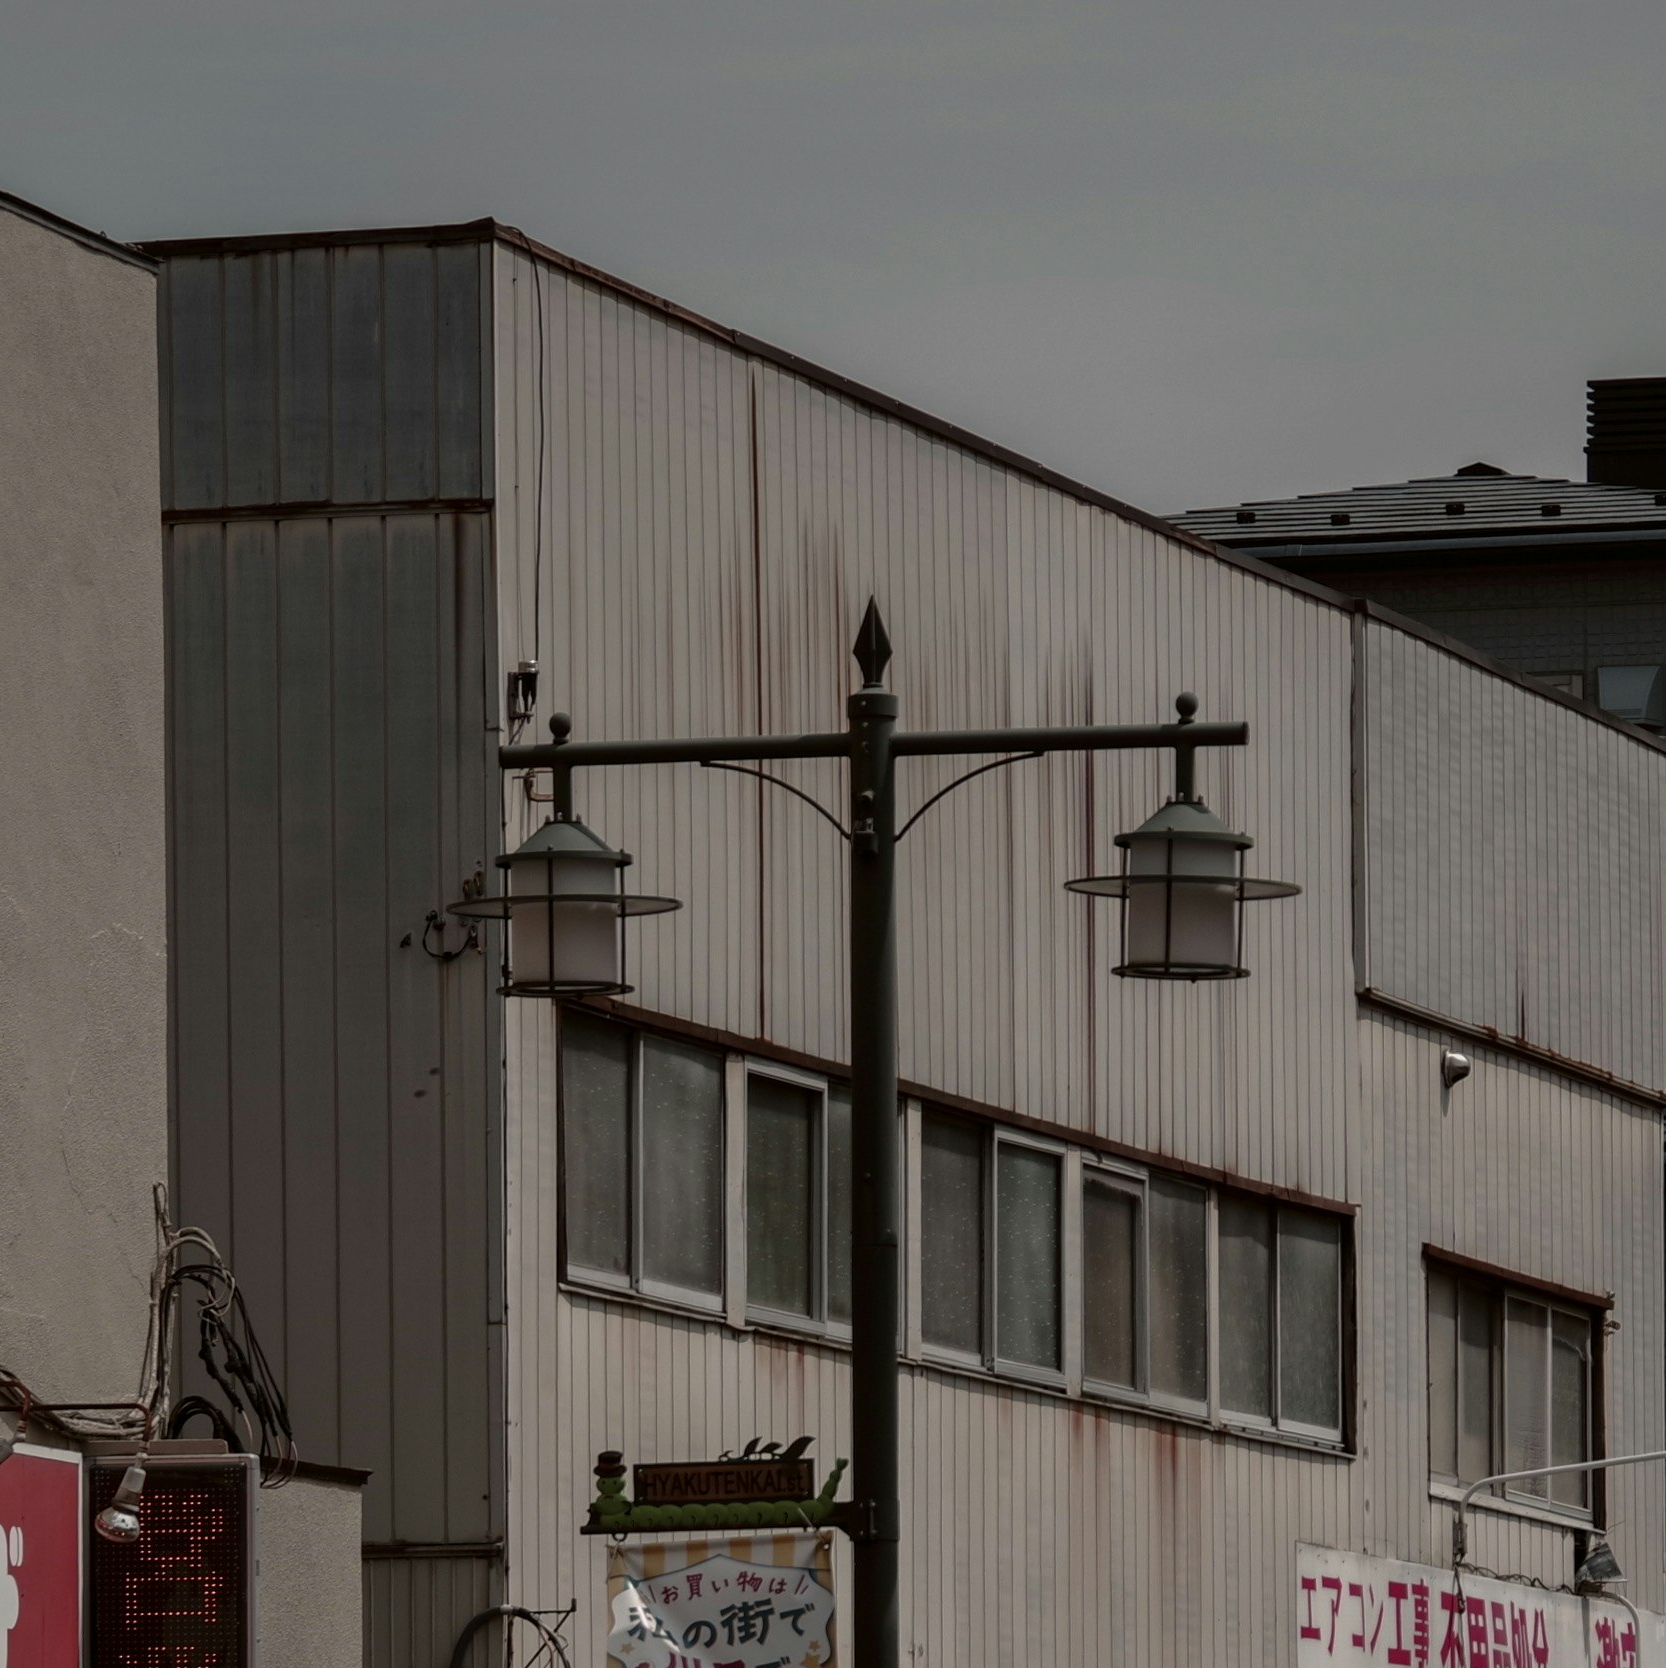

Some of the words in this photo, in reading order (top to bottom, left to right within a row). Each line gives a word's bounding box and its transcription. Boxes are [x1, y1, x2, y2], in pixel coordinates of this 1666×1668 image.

[644, 1469, 805, 1497] HYAKUTENKAI.st
[660, 1570, 789, 1606] お買い物は
[627, 1598, 816, 1649] 私の街で
